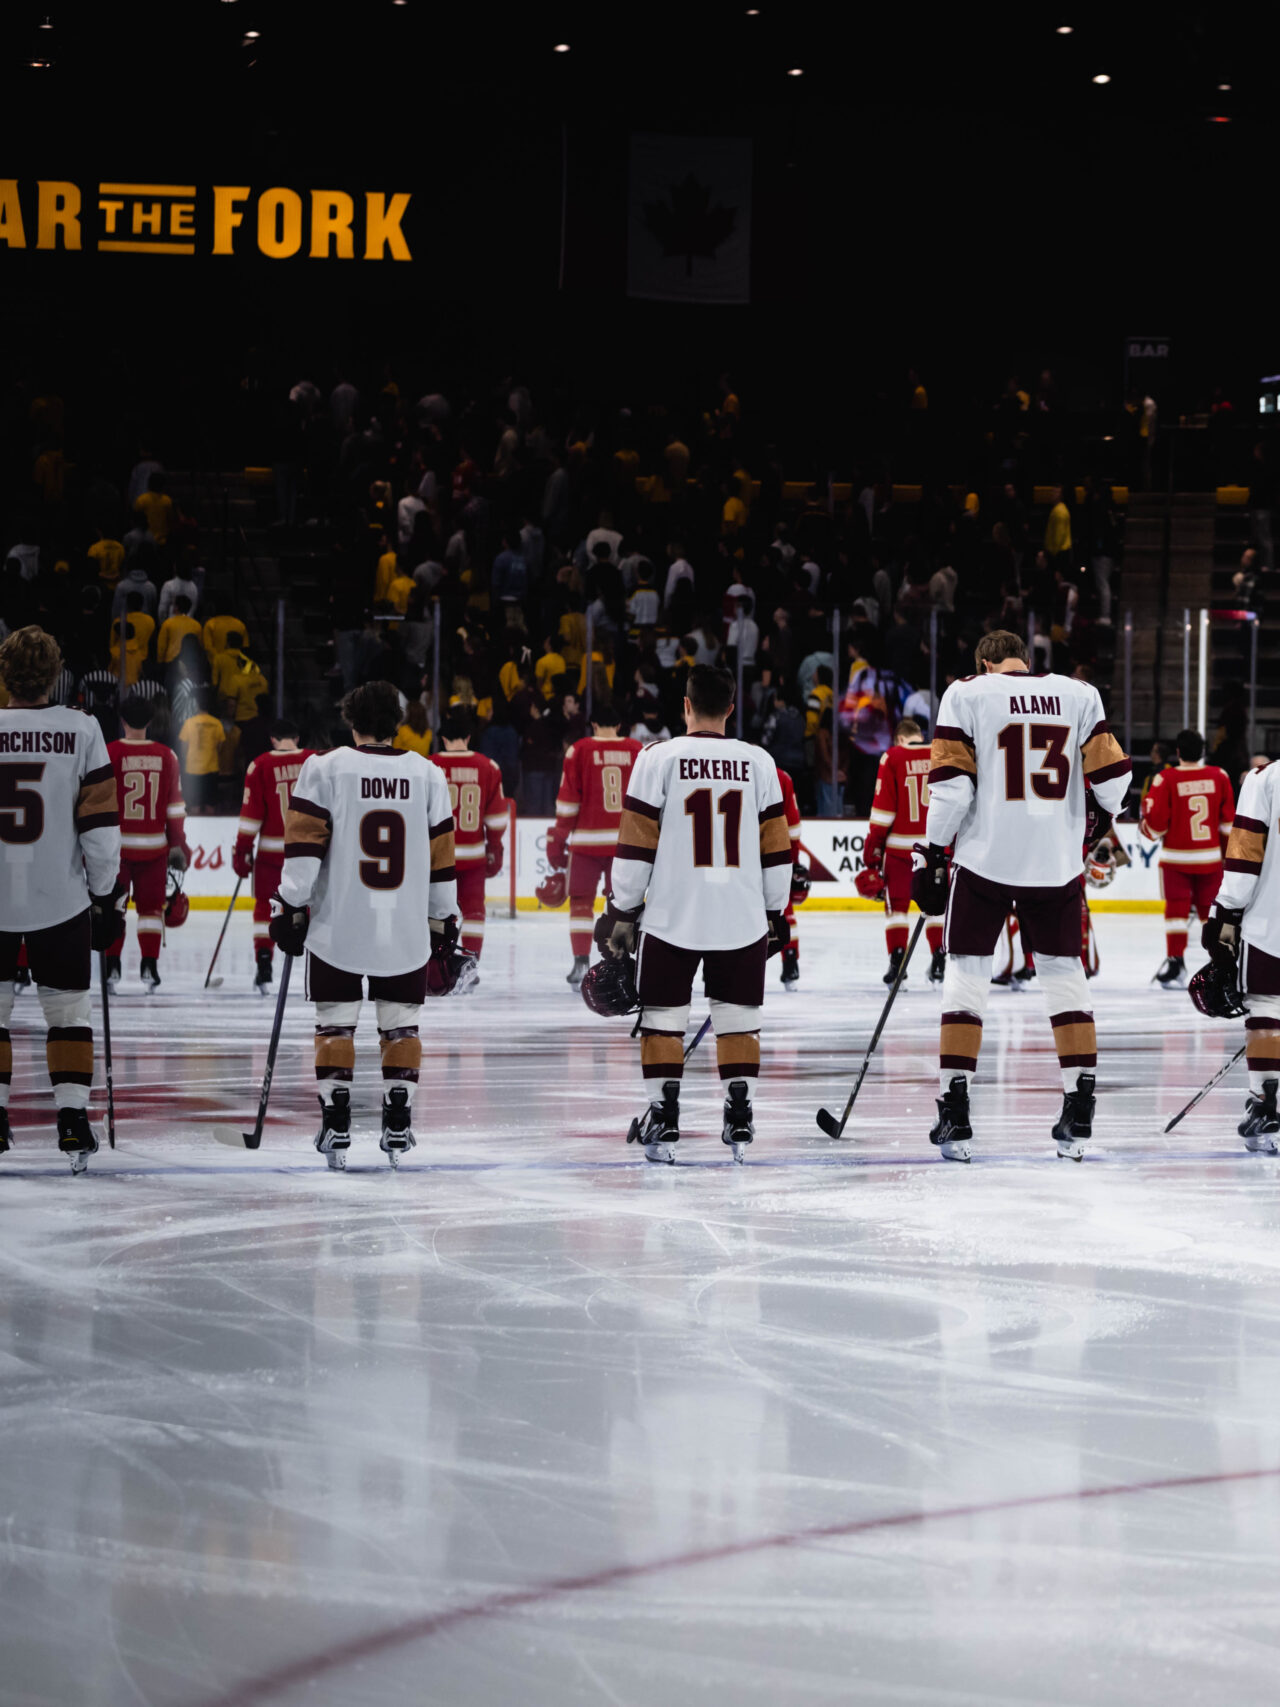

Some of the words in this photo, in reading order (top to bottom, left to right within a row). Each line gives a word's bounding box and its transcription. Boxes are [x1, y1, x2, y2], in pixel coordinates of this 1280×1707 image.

[98, 199, 196, 237] THE
[211, 184, 413, 262] FORK
[1128, 343, 1170, 358] BAR
[1009, 695, 1061, 716] ALAMI
[679, 758, 750, 782] ECKERLE
[998, 722, 1071, 801] 13
[0, 761, 46, 845] 5
[123, 771, 160, 820] 21
[361, 777, 410, 800] DOWD
[602, 766, 623, 812] 8
[685, 788, 743, 868] 11
[1188, 795, 1212, 841] 2
[360, 809, 405, 890] 9
